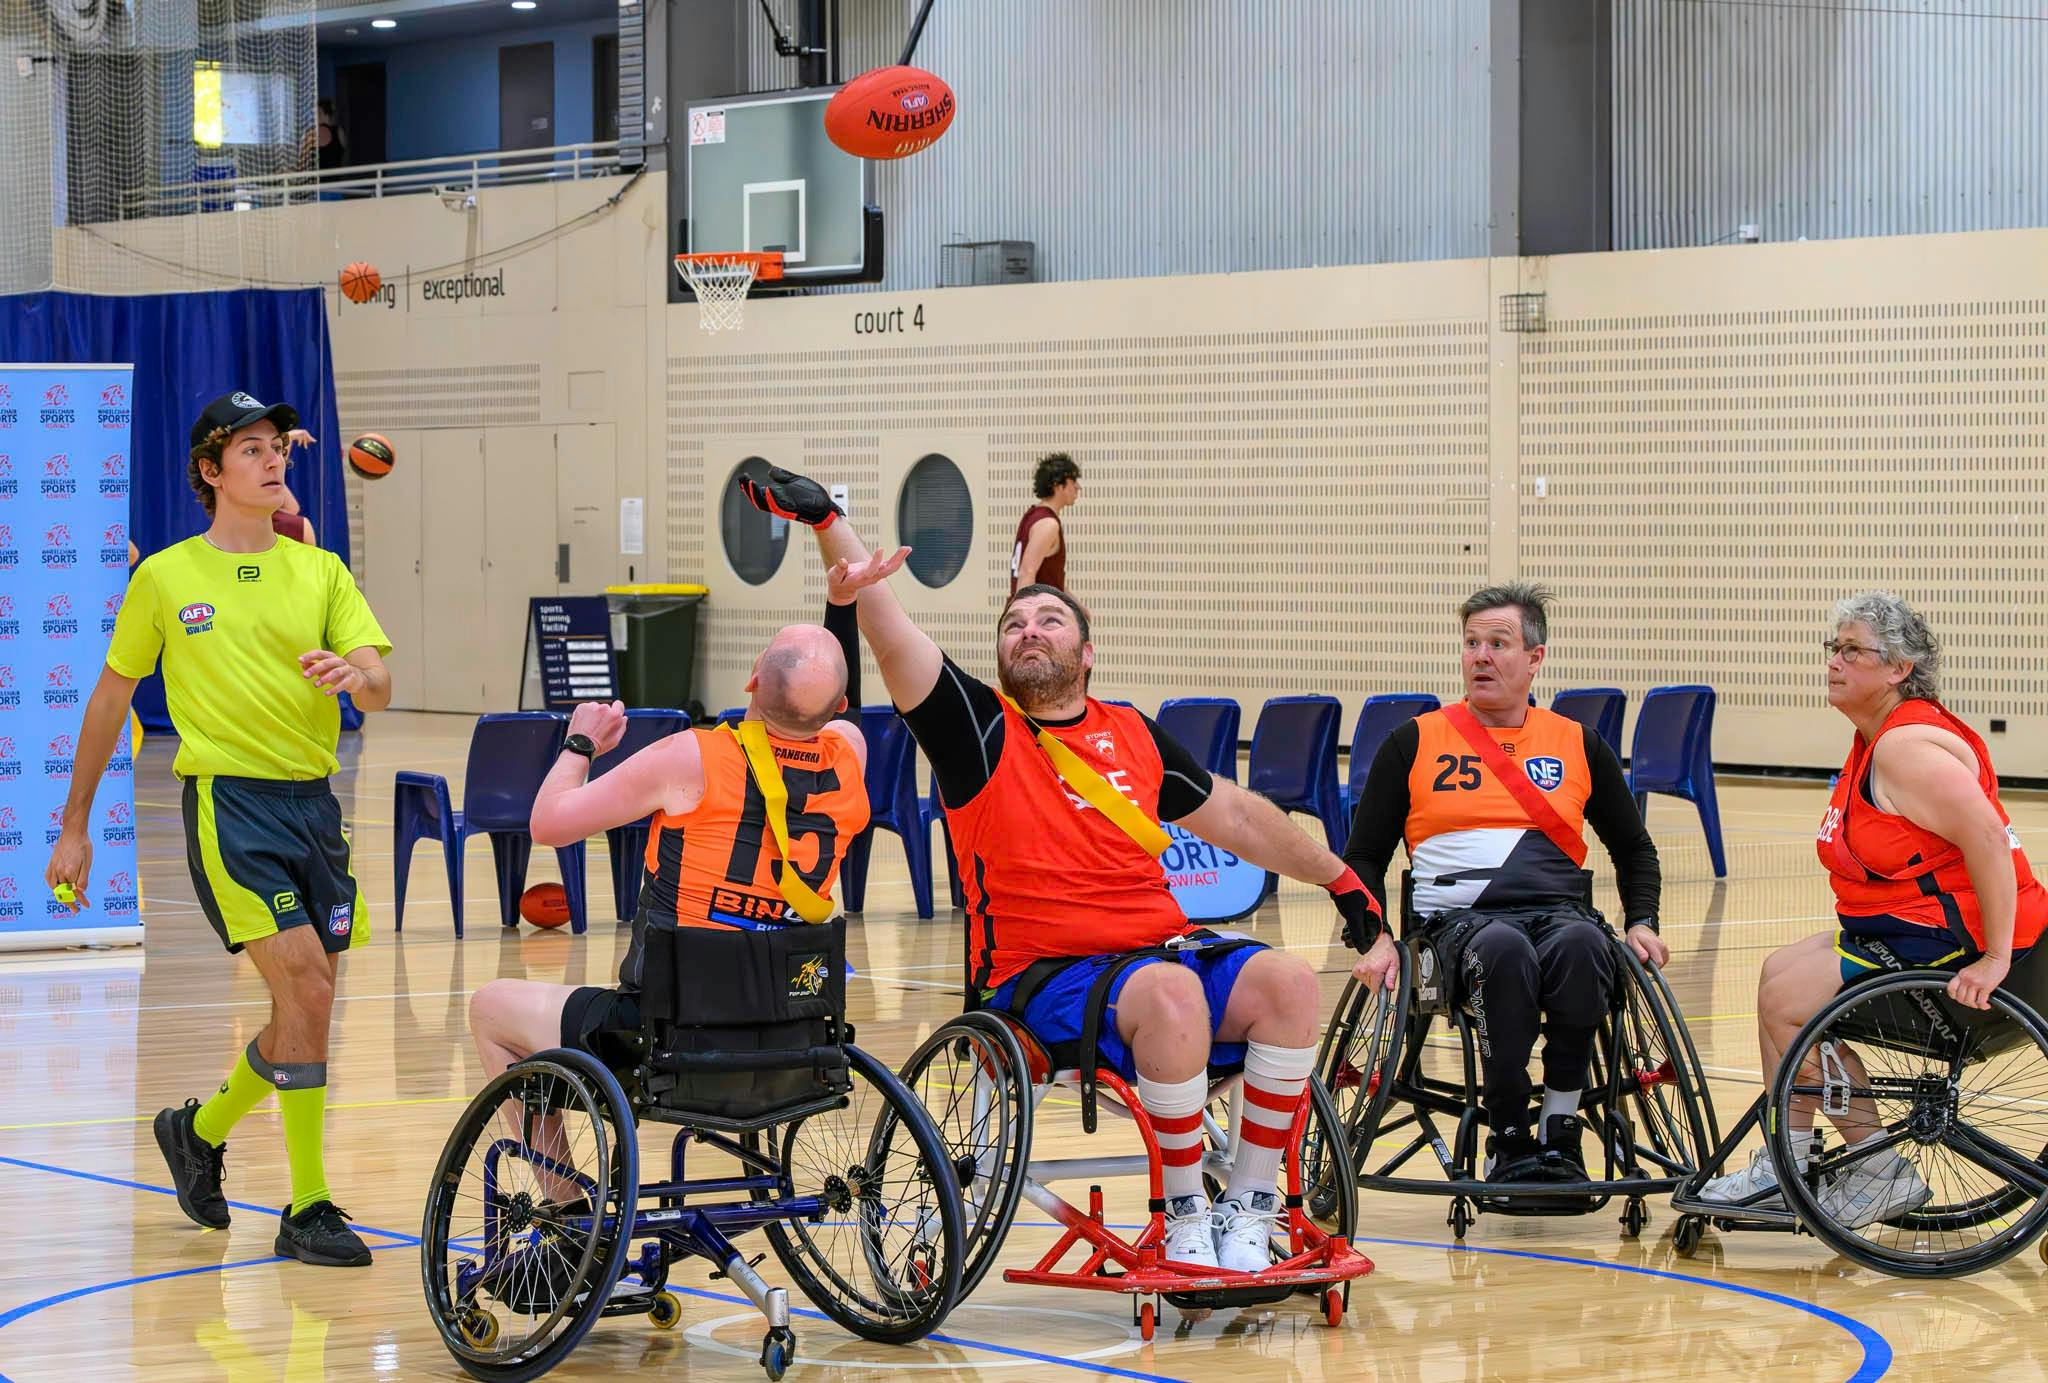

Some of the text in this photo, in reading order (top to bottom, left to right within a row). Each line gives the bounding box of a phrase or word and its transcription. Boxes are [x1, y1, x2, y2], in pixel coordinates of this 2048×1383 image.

[866, 93, 952, 132] SHERRIN
[423, 267, 505, 304] exceptional
[855, 304, 925, 334] court 4
[0, 414, 18, 423] RTS
[40, 414, 76, 423] SPORTS
[98, 414, 130, 423] SPORTS
[0, 485, 19, 494] RTS
[41, 484, 77, 493] SPORTS
[100, 485, 128, 494] SPORTS
[0, 555, 19, 564] ORTS
[42, 554, 78, 563] SPORTS
[100, 554, 128, 563] SPORTS
[182, 606, 213, 622] AFL
[540, 605, 564, 614] sports
[541, 614, 571, 624] training
[0, 626, 20, 635] ORTS
[43, 624, 79, 633] SPORTS
[185, 621, 214, 636] NSW/ACT
[542, 623, 568, 633] facility
[0, 696, 21, 705] ORTS
[44, 694, 79, 703] SPORTS
[1085, 731, 1112, 740] SYDNEY
[0, 766, 22, 775] ORTS
[45, 765, 73, 774] SPORT
[1432, 754, 1482, 792] 25
[1530, 759, 1560, 781] NE
[725, 745, 840, 892] 15
[0, 836, 23, 845] ORTS
[104, 831, 135, 841] SPORTS
[1161, 841, 1239, 871] ORTS
[1166, 871, 1218, 888] SW/ACT
[104, 901, 137, 911] SPORTS
[714, 888, 806, 923] BIN
[0, 907, 24, 916] ORTS
